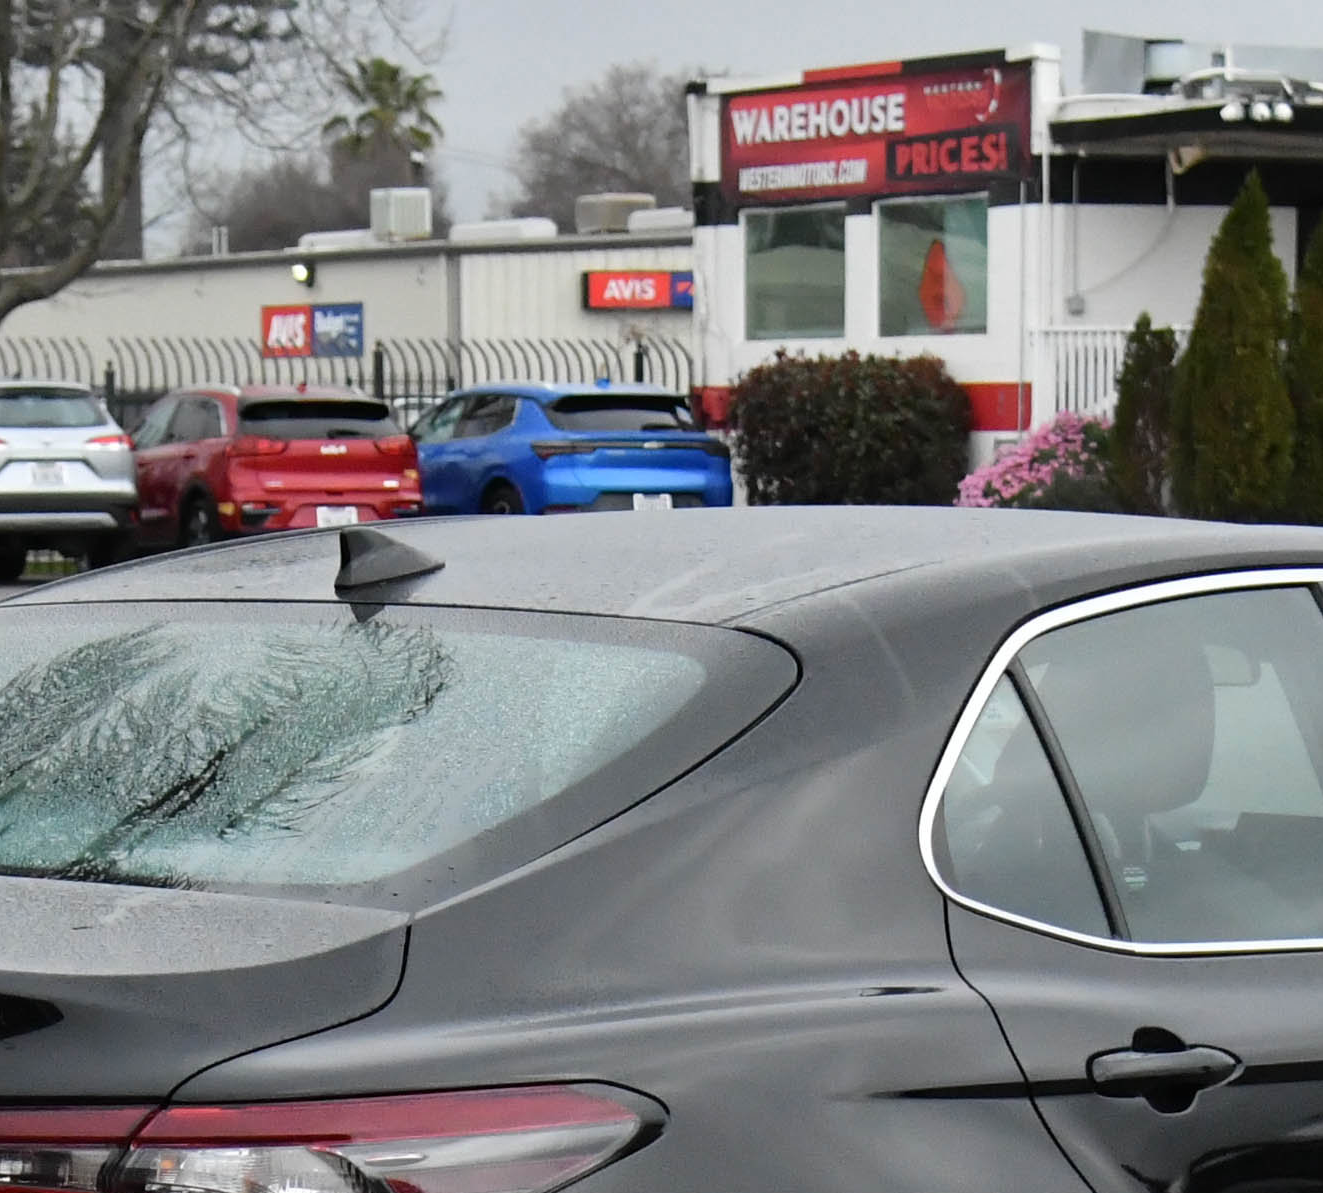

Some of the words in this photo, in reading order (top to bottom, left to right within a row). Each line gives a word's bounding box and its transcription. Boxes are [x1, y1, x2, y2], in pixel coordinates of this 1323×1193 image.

[731, 93, 906, 146] WAREHOUSE
[895, 132, 1008, 176] PRICES!
[603, 278, 657, 301] AVIS
